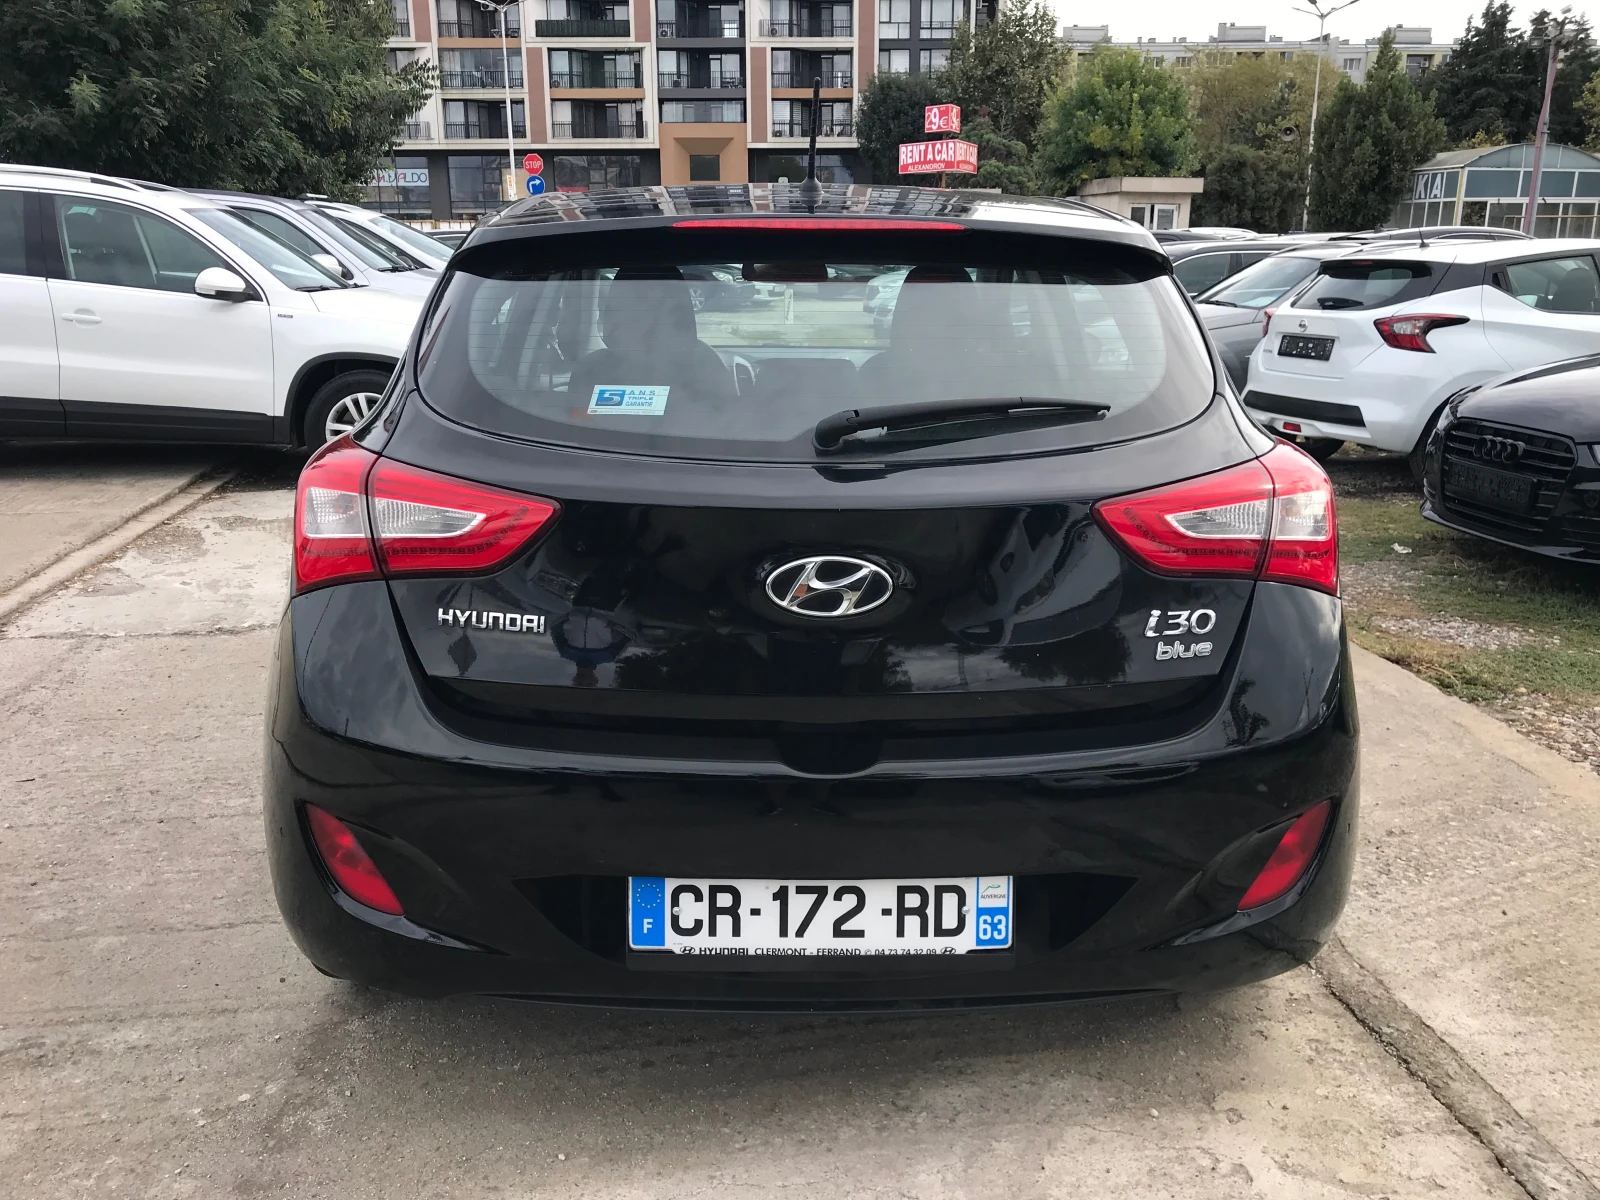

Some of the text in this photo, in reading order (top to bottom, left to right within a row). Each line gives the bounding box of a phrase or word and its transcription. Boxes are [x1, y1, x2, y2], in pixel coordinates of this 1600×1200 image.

[525, 159, 542, 169] STOP
[900, 142, 955, 165] RENT A CAR
[908, 162, 946, 171] ALEXANDROV
[438, 608, 546, 634] HYUNDAI
[1144, 608, 1217, 637] i30
[1156, 640, 1214, 661] blue
[643, 918, 653, 934] F
[978, 914, 1007, 940] 63
[700, 947, 749, 955] HYUNDAI
